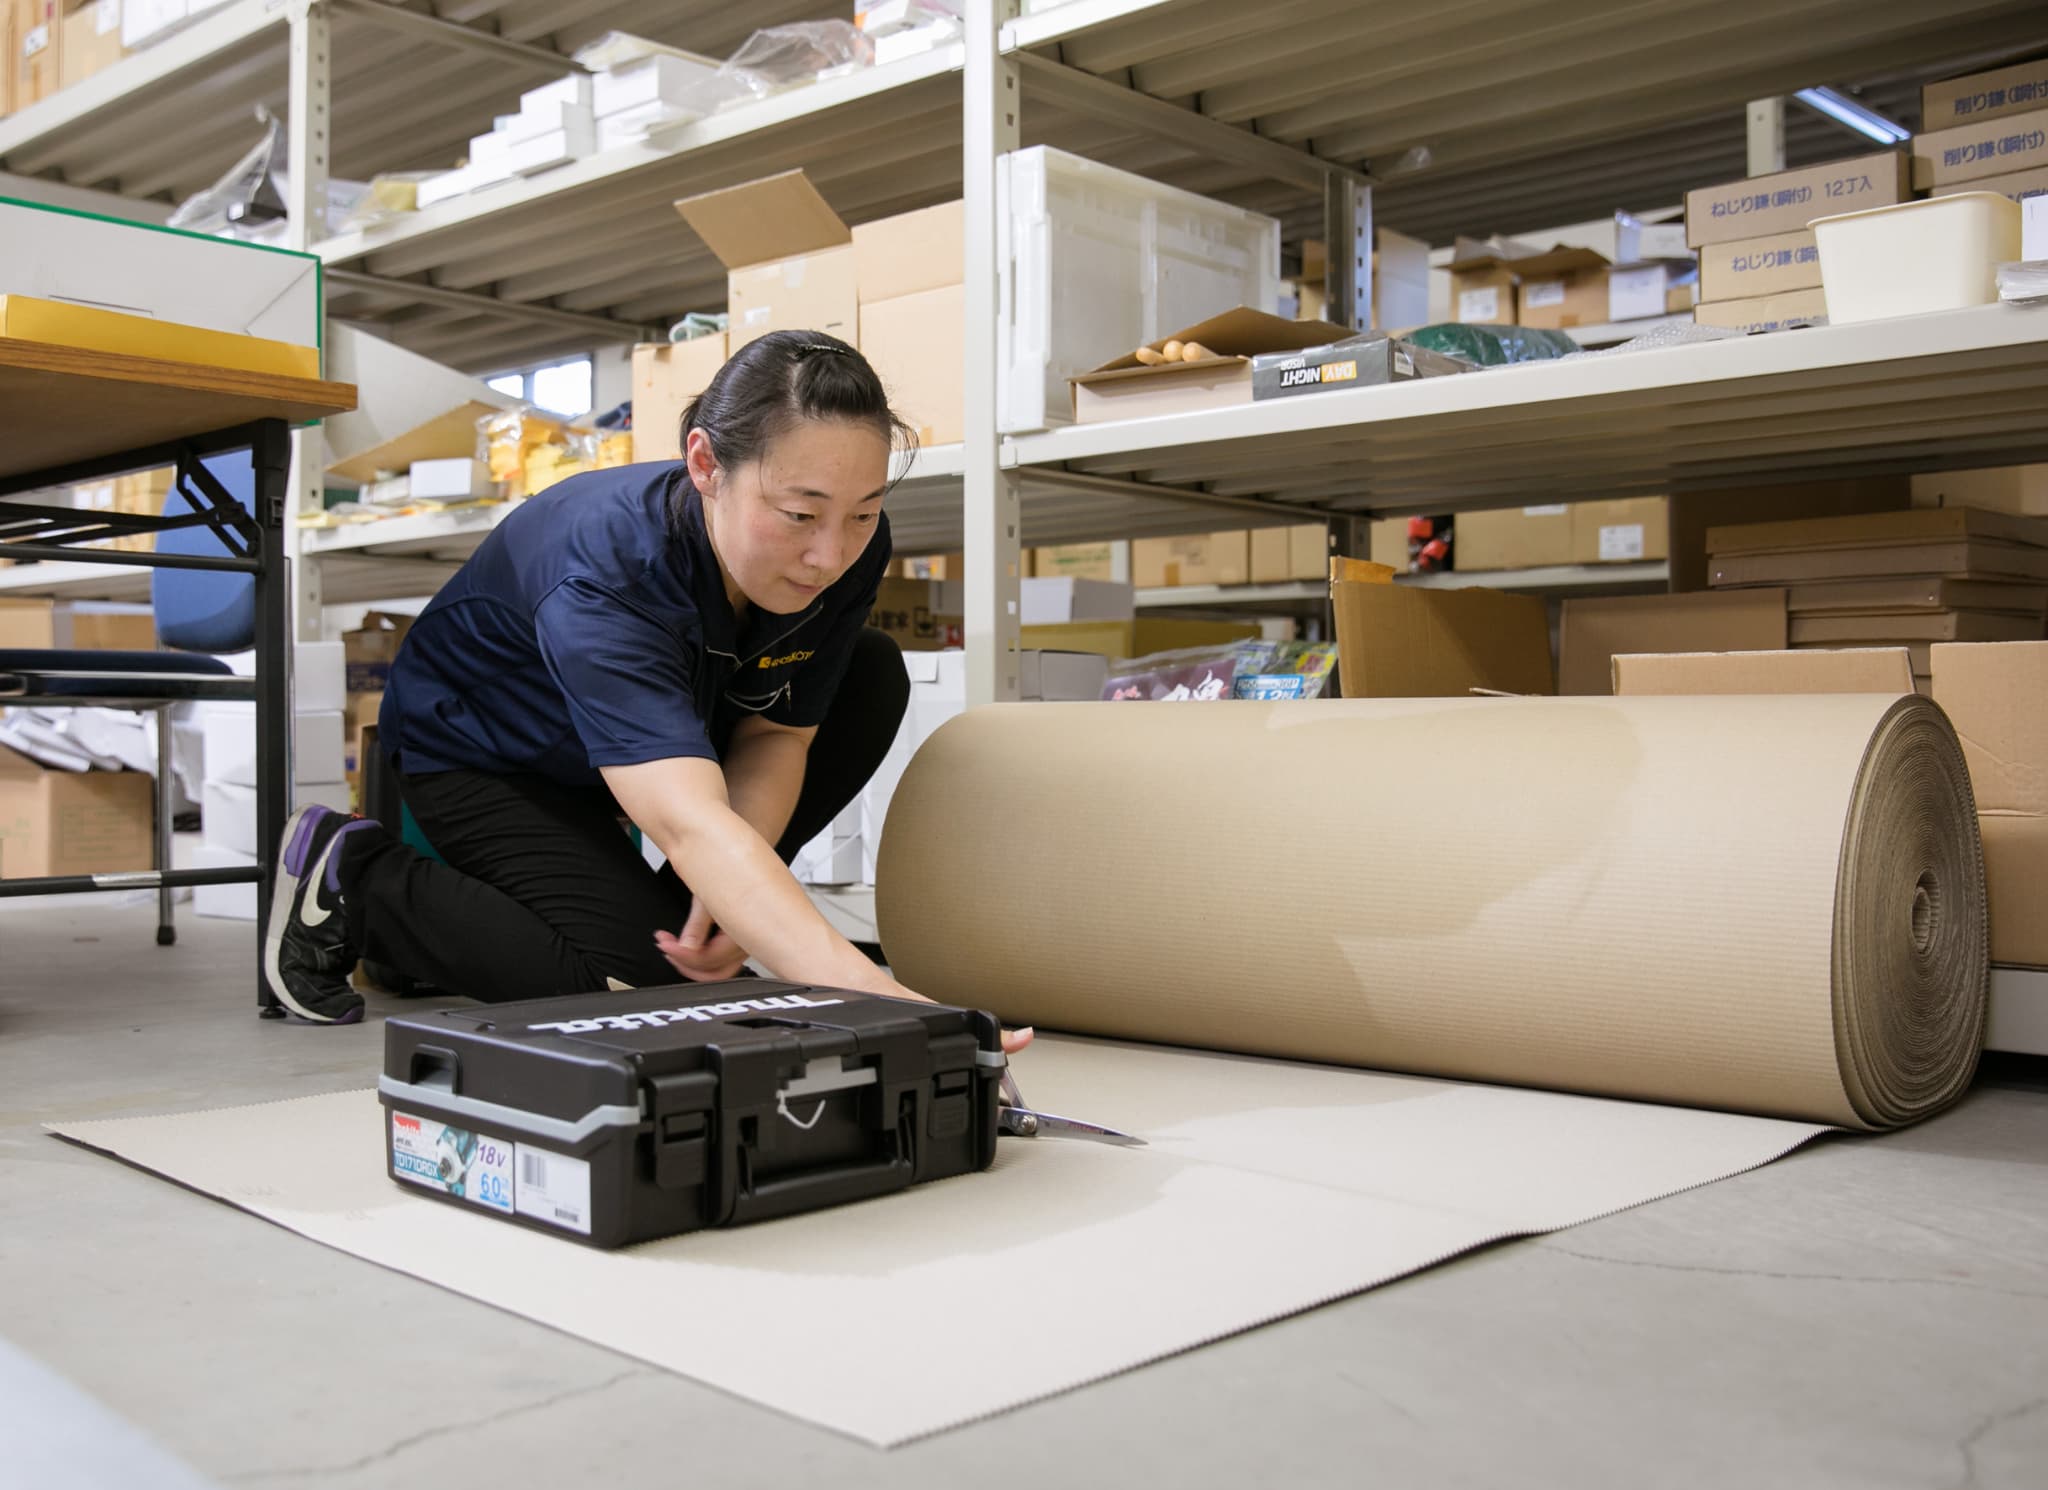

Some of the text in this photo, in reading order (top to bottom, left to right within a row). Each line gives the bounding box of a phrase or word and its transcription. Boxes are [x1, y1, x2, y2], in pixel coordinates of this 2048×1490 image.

[1824, 175, 1873, 198] 12丁入
[1280, 367, 1321, 387] NIGHT
[527, 994, 845, 1034] makita
